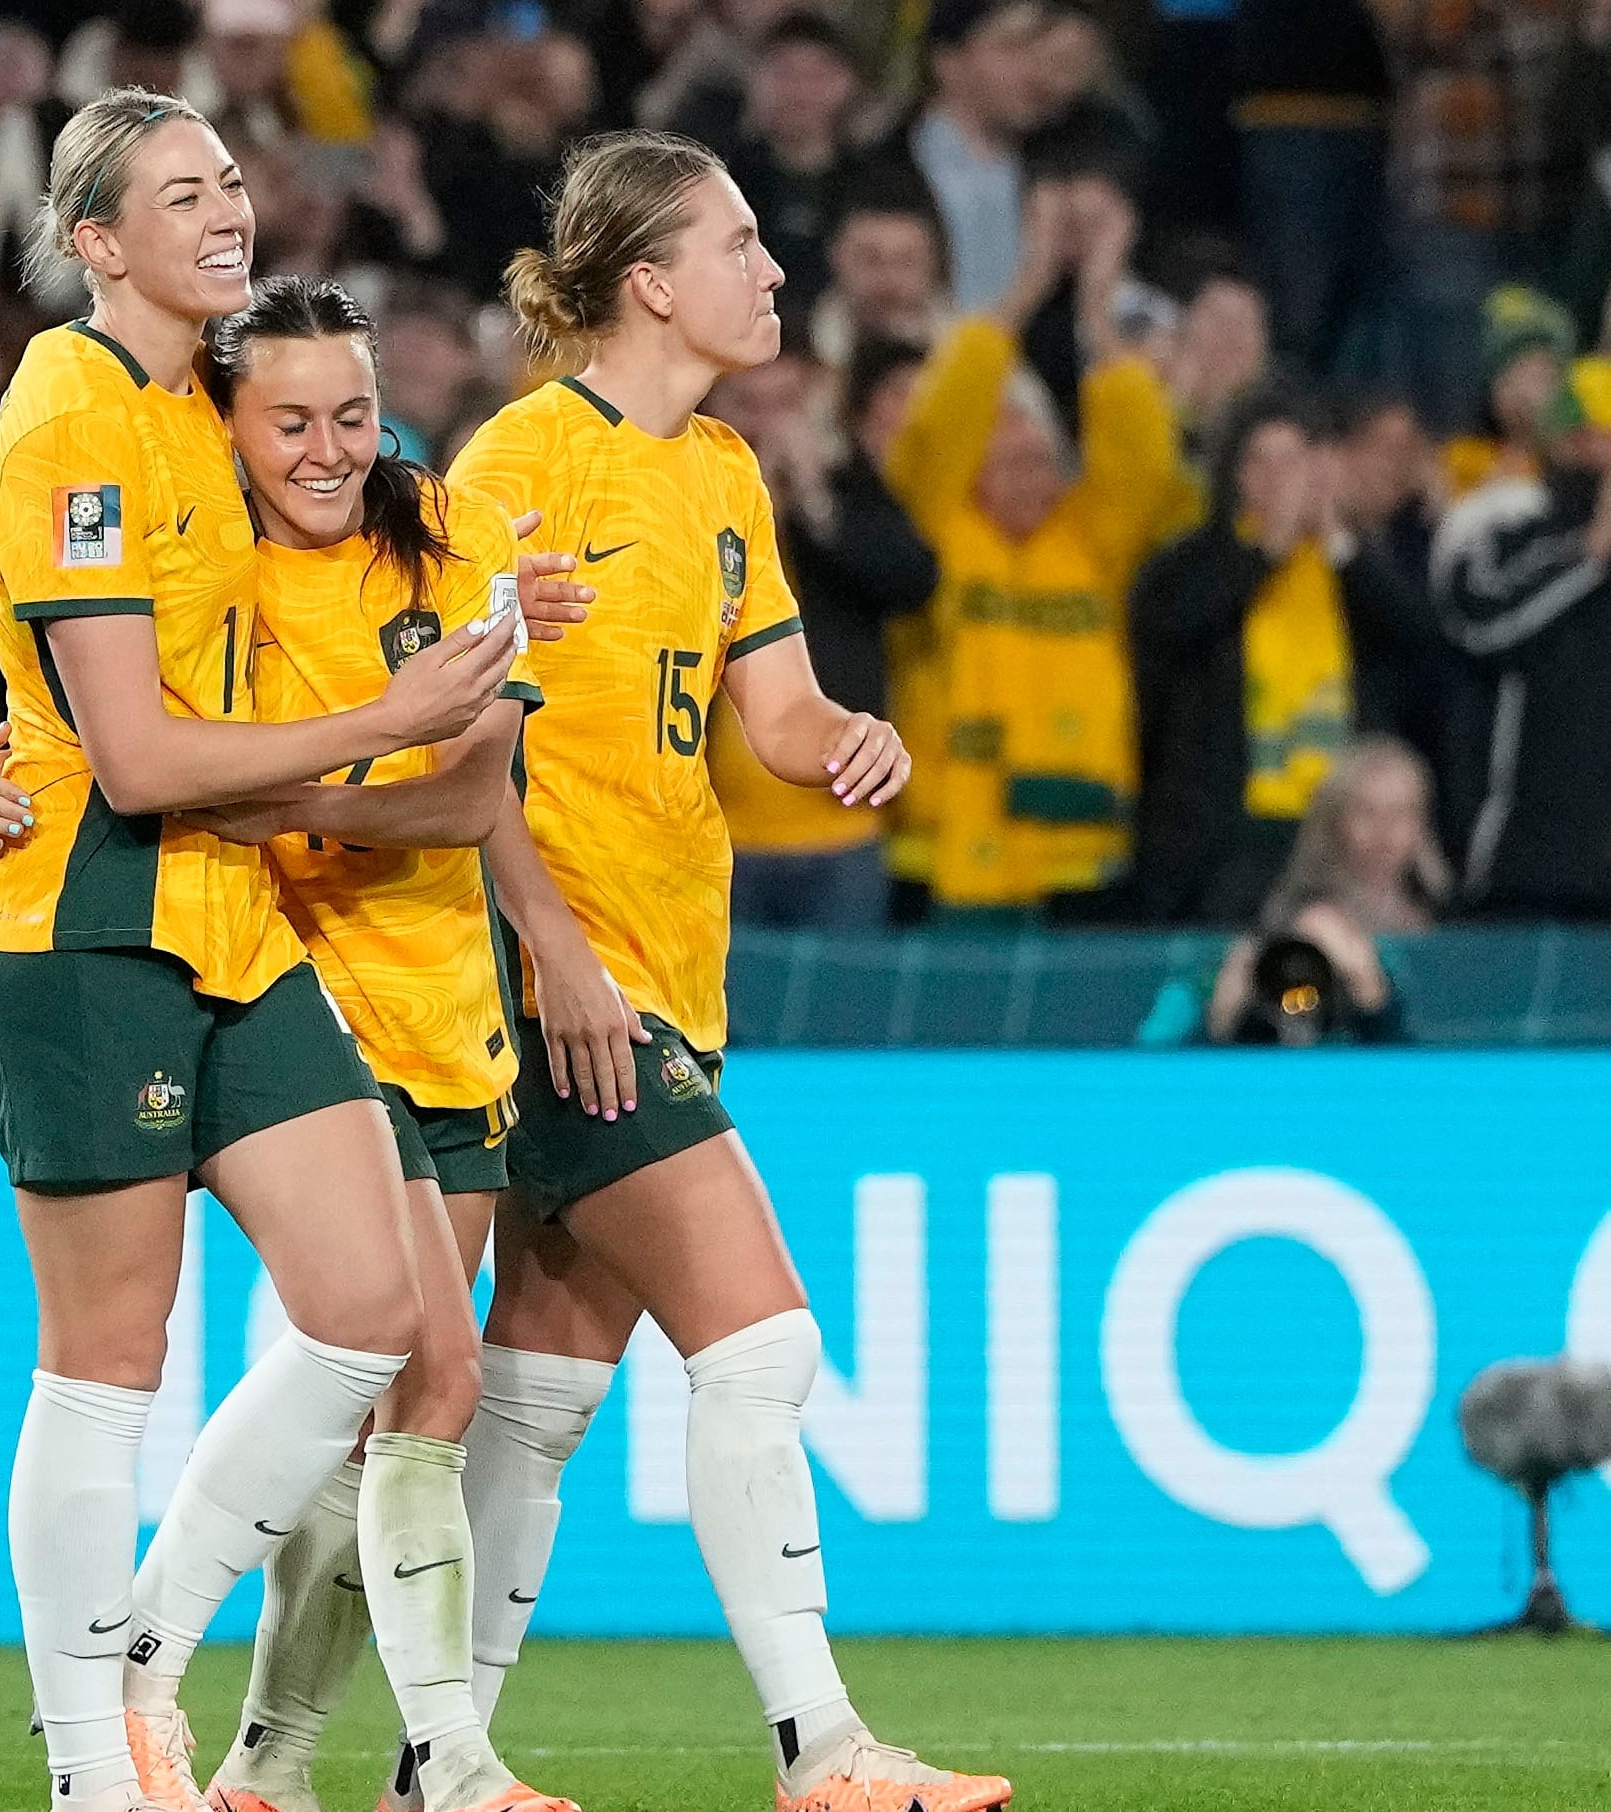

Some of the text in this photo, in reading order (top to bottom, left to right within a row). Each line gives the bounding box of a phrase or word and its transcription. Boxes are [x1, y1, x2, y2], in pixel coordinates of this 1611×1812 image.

[656, 648, 703, 756] 15
[138, 1108, 181, 1120] AUSTRALIA
[138, 1166, 1439, 1597] INIQ
